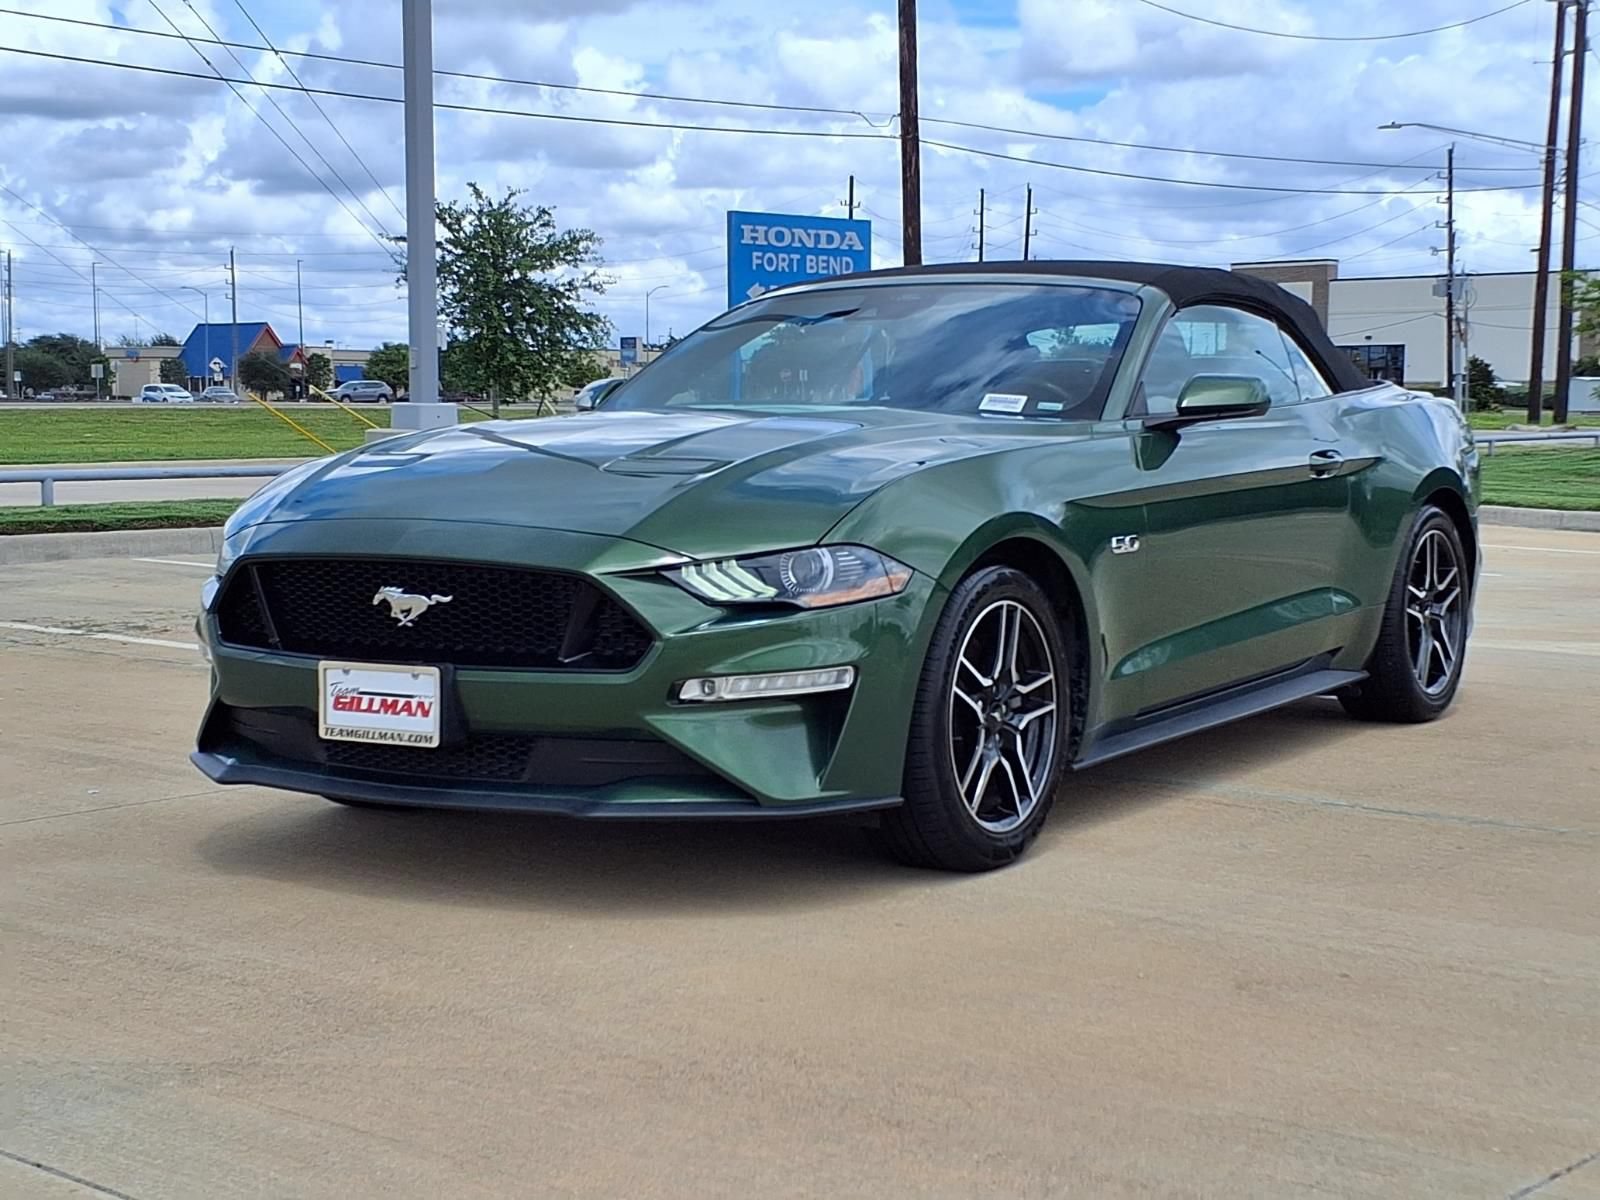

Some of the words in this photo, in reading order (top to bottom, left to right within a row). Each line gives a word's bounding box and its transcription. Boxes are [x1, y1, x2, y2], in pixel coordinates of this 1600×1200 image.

[740, 224, 864, 250] HONDA
[752, 251, 801, 273] FORT
[806, 254, 854, 275] BEND
[1111, 534, 1140, 554] 5.0
[330, 681, 360, 697] Team
[332, 695, 433, 718] GILLMAN
[324, 727, 433, 744] TEAMGILLMAN.COM
